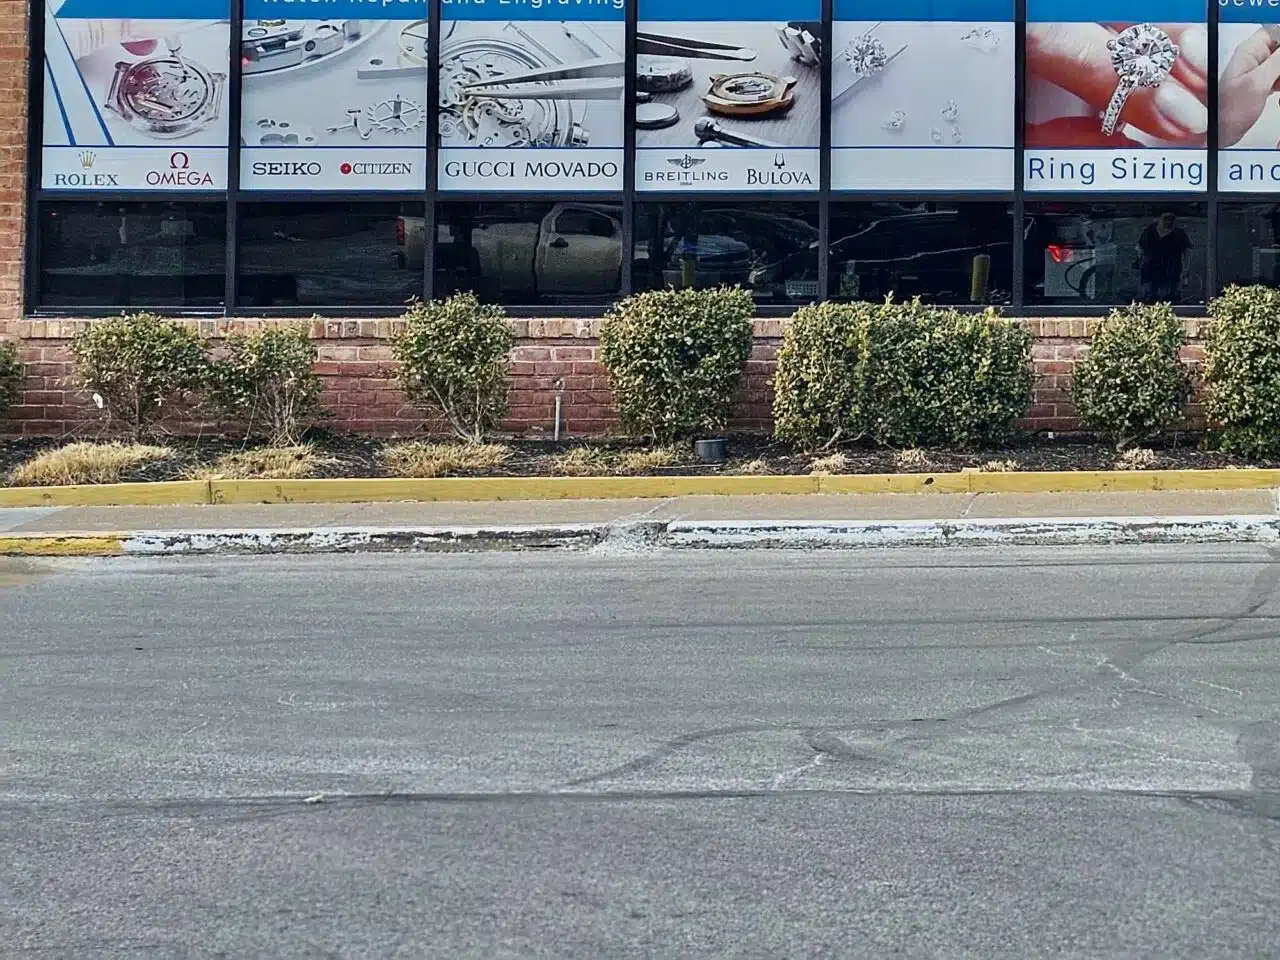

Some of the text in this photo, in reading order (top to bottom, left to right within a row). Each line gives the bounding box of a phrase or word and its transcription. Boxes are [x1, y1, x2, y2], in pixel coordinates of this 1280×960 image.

[252, 161, 322, 176] SEIKO
[352, 162, 413, 175] CITIZEN
[444, 161, 516, 178] GUCCI
[524, 161, 618, 178] MOVADO
[644, 171, 729, 181] BREITLING
[747, 167, 813, 185] BULOVA
[1027, 158, 1096, 183] Ring
[1110, 157, 1204, 184] Sizing
[54, 173, 119, 187] ROLEX
[146, 171, 214, 186] OMEGA
